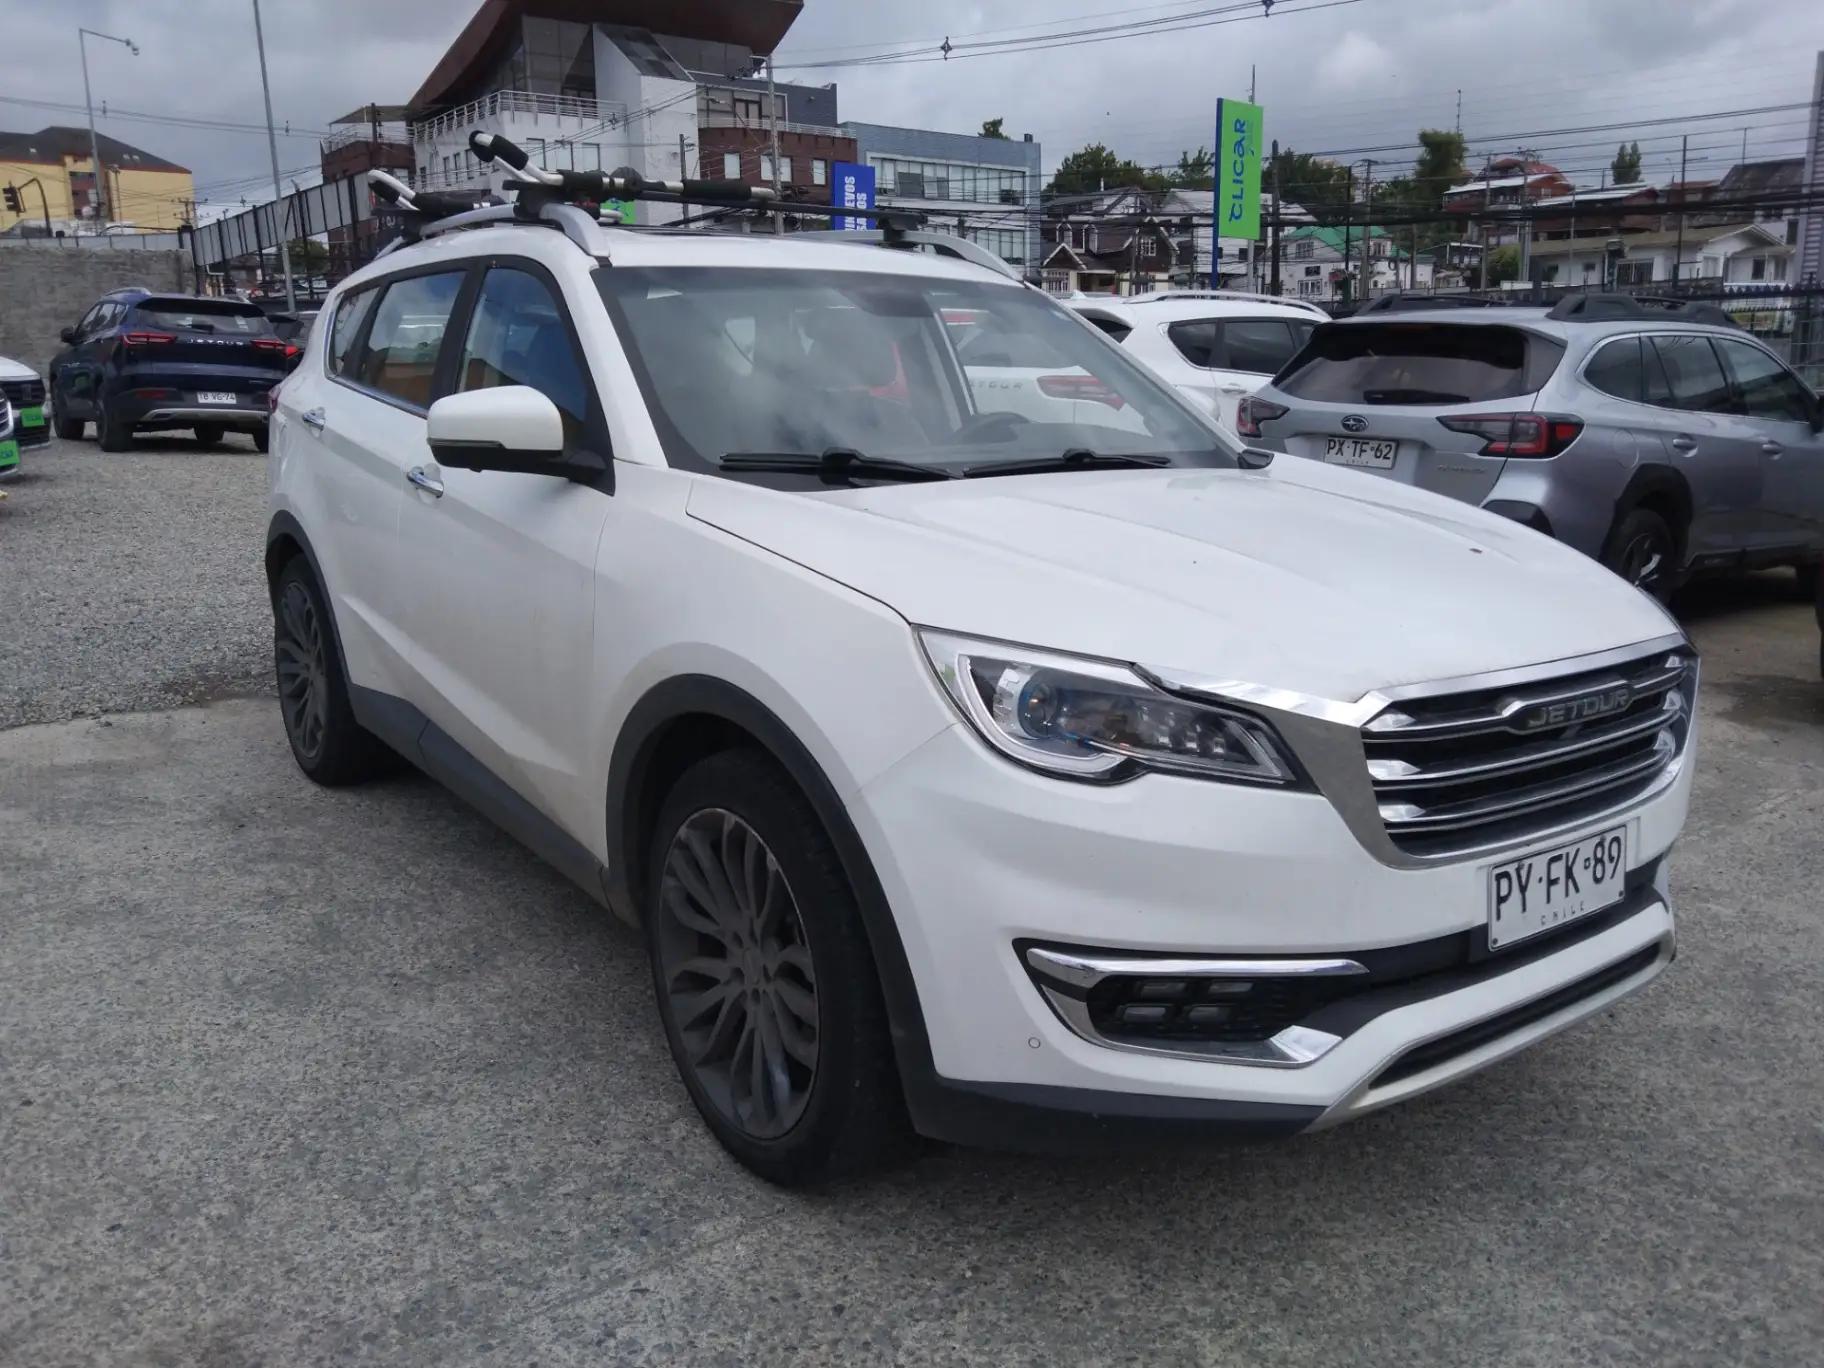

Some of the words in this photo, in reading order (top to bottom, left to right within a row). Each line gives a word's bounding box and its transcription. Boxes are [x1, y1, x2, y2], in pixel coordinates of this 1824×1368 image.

[1229, 118, 1246, 222] CLICAR
[1527, 688, 1631, 728] JETOUR
[1540, 900, 1586, 926] CHILE
